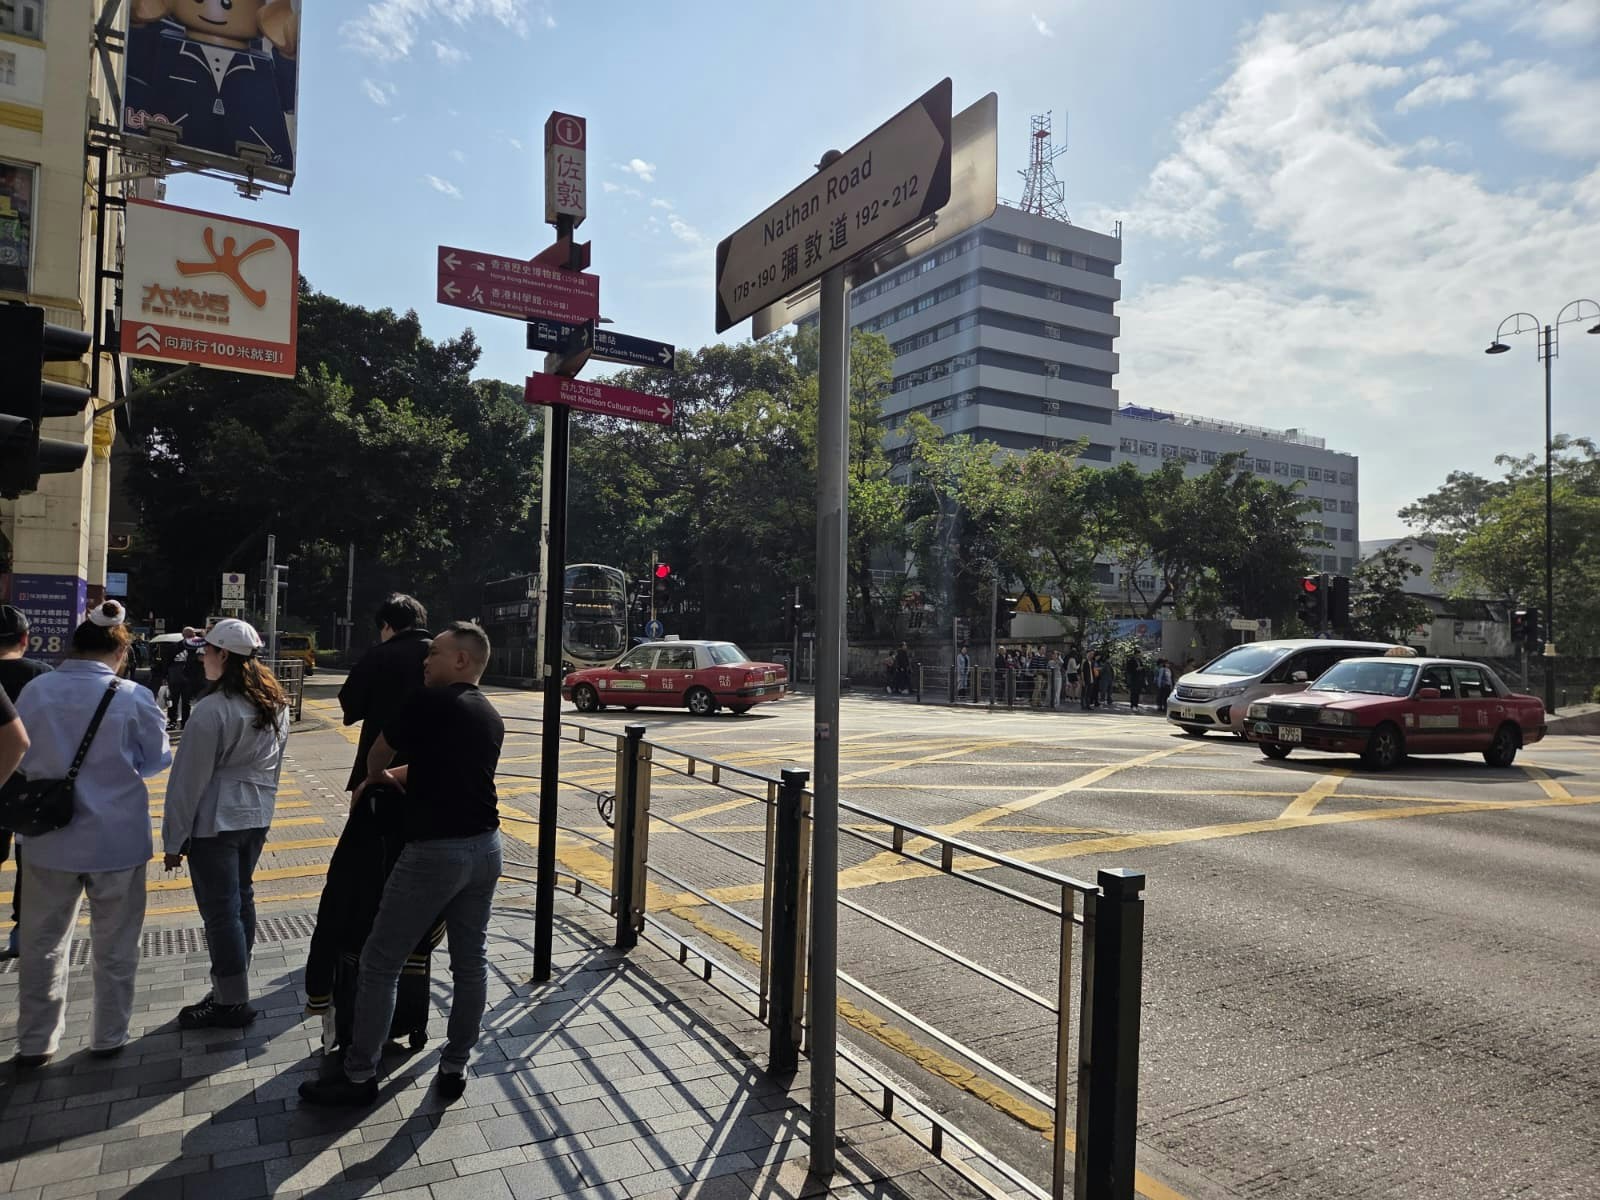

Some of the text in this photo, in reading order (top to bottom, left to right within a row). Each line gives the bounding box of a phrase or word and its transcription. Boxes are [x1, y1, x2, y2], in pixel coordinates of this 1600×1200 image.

[557, 153, 583, 211] 佐敦
[763, 151, 873, 247] Nathan Road
[733, 174, 919, 304] 178-190 彌敦道 192-212
[490, 272, 506, 281] Hong
[507, 275, 522, 284] Kong
[142, 283, 231, 313] 大快活
[490, 300, 506, 309] Hong
[507, 303, 524, 312] Kong
[141, 303, 230, 325] Fairwood
[610, 347, 628, 356] Coach
[629, 351, 655, 362] Terminus
[560, 380, 602, 398] 西九文化區
[560, 391, 654, 417] West Kowloon Cultural District
